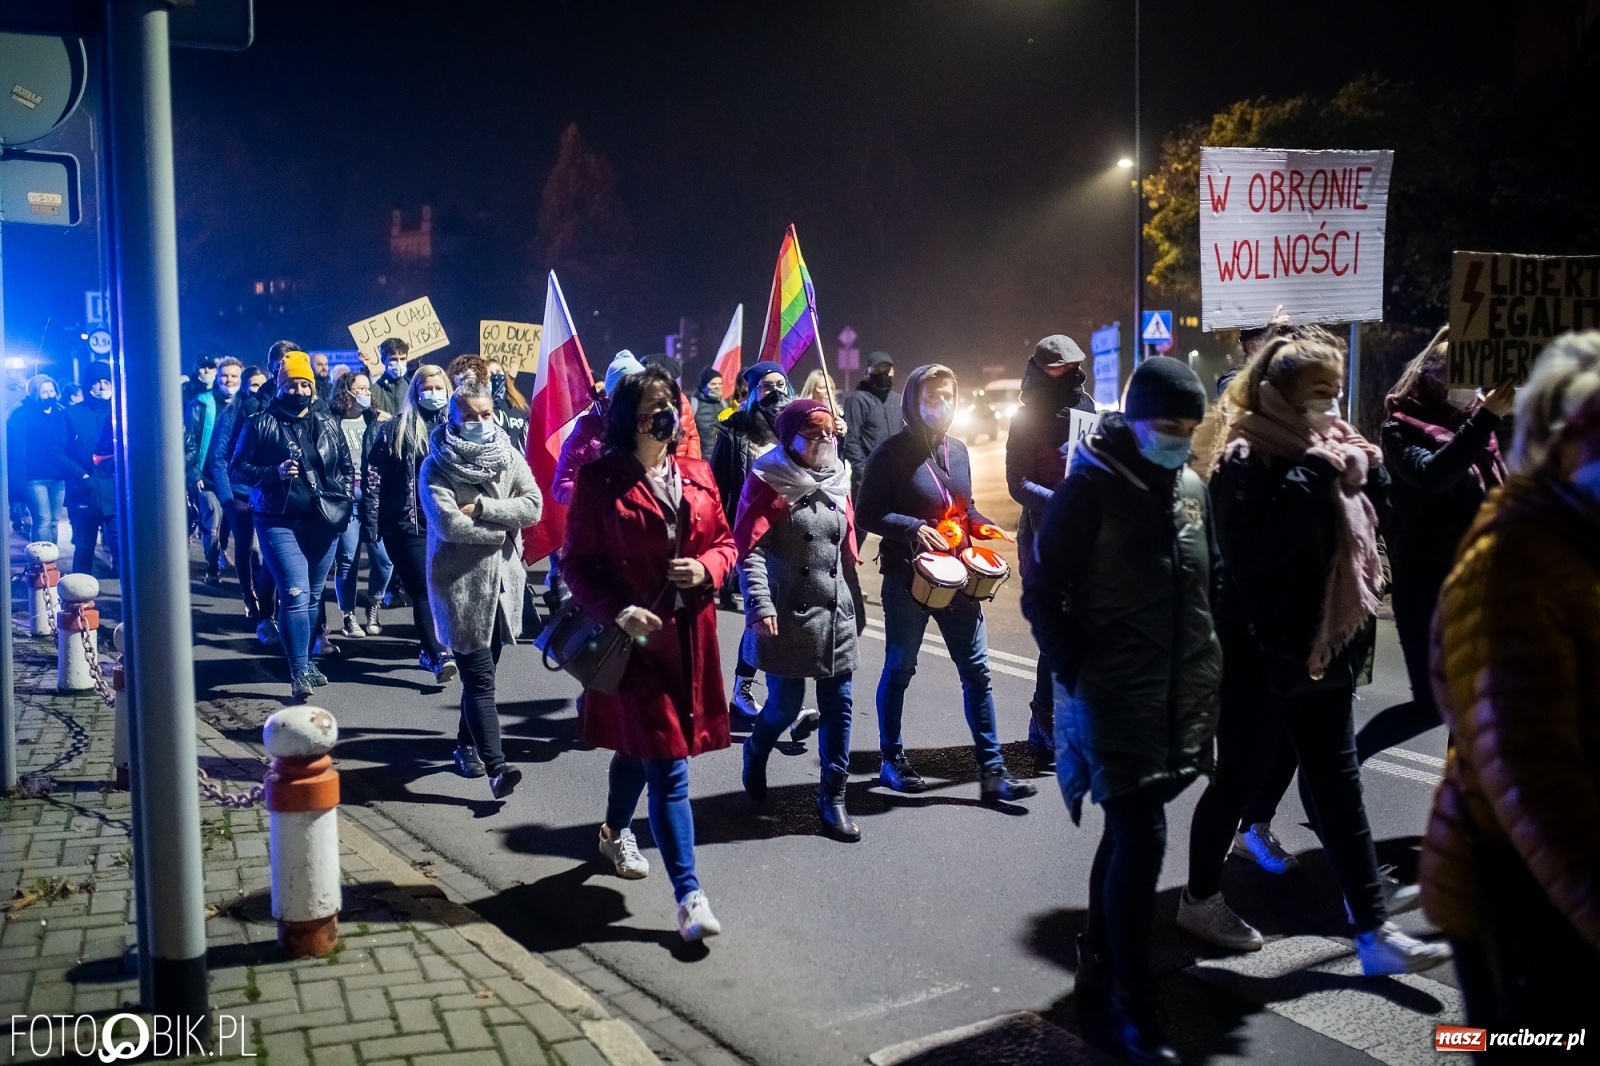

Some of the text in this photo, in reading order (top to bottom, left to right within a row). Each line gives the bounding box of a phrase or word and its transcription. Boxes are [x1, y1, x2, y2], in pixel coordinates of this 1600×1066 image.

[1207, 166, 1373, 213] W OBRONIE
[1214, 220, 1360, 282] WOLNOŚCI
[360, 303, 431, 344] JEJ CIAŁO
[483, 324, 541, 342] GO DUCK
